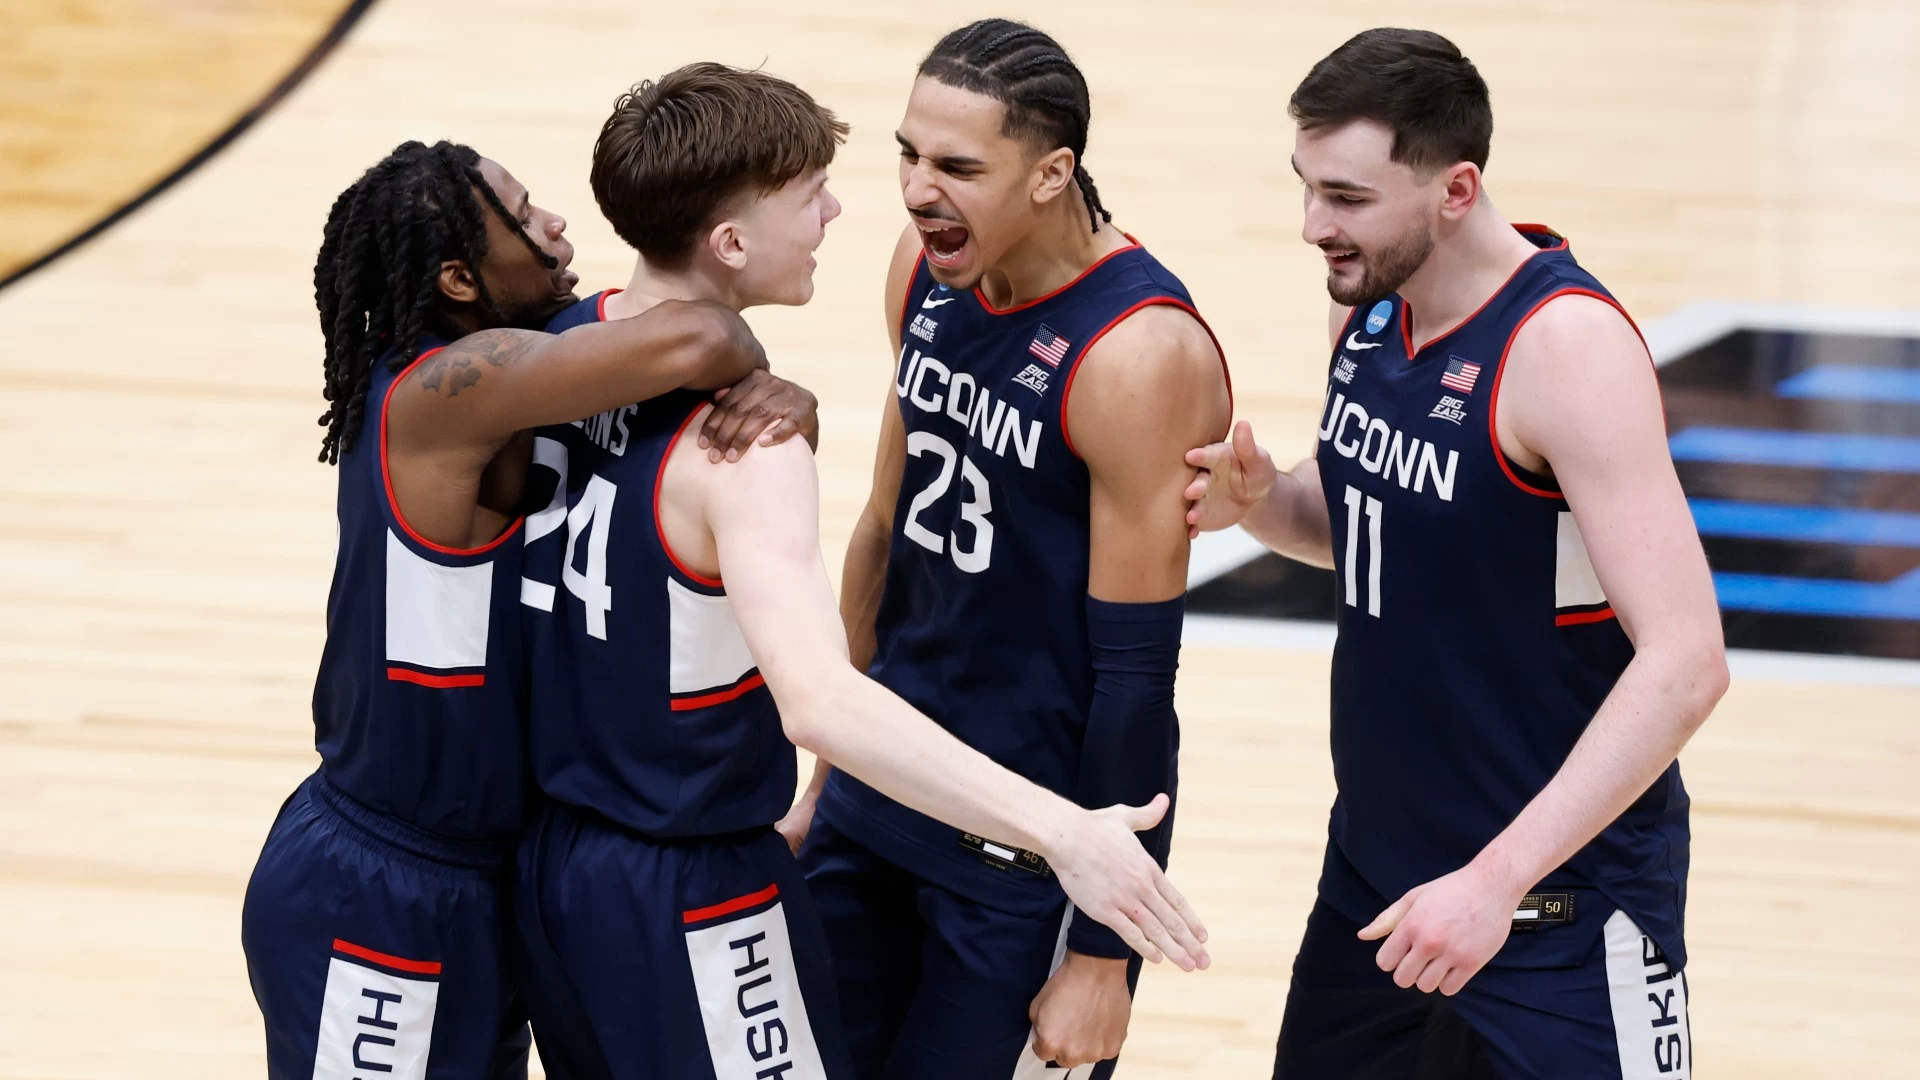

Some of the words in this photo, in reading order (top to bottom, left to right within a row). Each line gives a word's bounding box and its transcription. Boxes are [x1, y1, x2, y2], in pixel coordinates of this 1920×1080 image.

[909, 322, 935, 343] CHANGE
[914, 313, 925, 326] BE
[922, 317, 938, 332] THE
[1024, 363, 1050, 381] BIG
[1341, 358, 1358, 374] THE
[1016, 370, 1049, 393] EAST
[896, 343, 1043, 469] UCONN
[1432, 404, 1467, 421] EAST
[1438, 395, 1465, 410] BIG
[1319, 384, 1459, 501] UCONN
[904, 431, 994, 573] 23
[520, 436, 618, 641] 24
[1343, 484, 1383, 618] 11
[1545, 901, 1561, 914] 50
[352, 987, 402, 1080] HU
